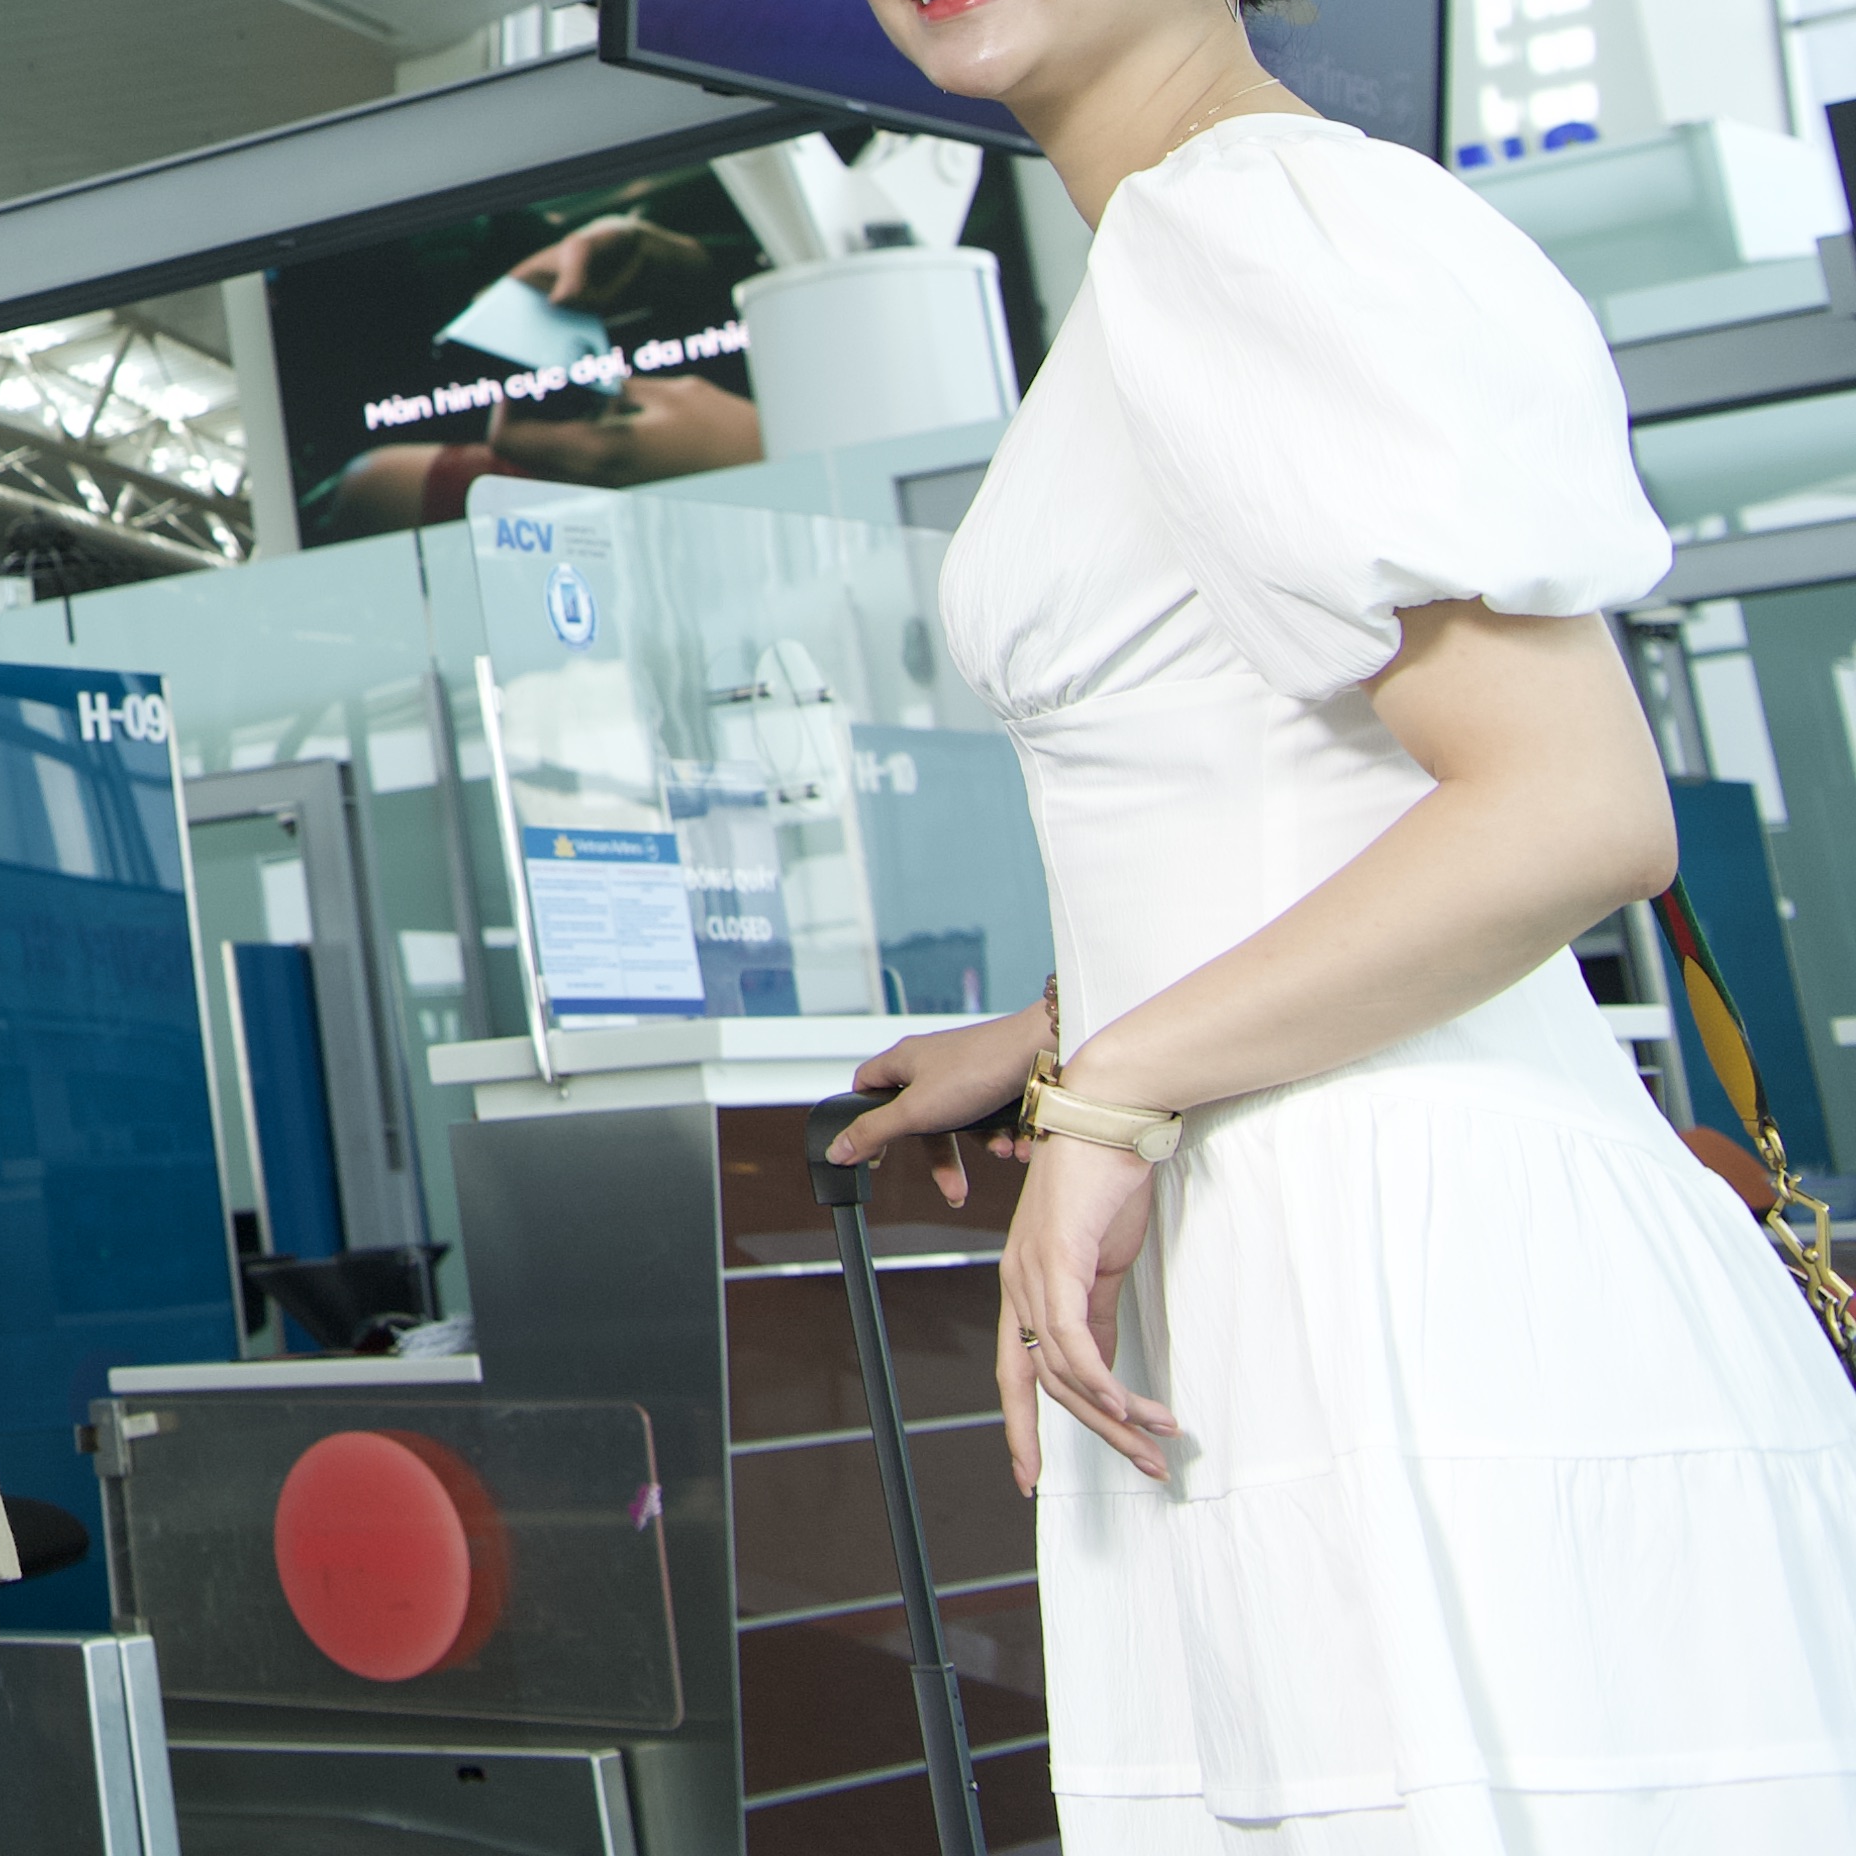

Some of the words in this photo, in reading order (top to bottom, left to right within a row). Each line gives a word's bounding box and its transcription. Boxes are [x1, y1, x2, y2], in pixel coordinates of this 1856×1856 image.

[496, 517, 553, 553] ACV
[77, 691, 168, 743] H-09
[707, 915, 773, 942] CLOSED
